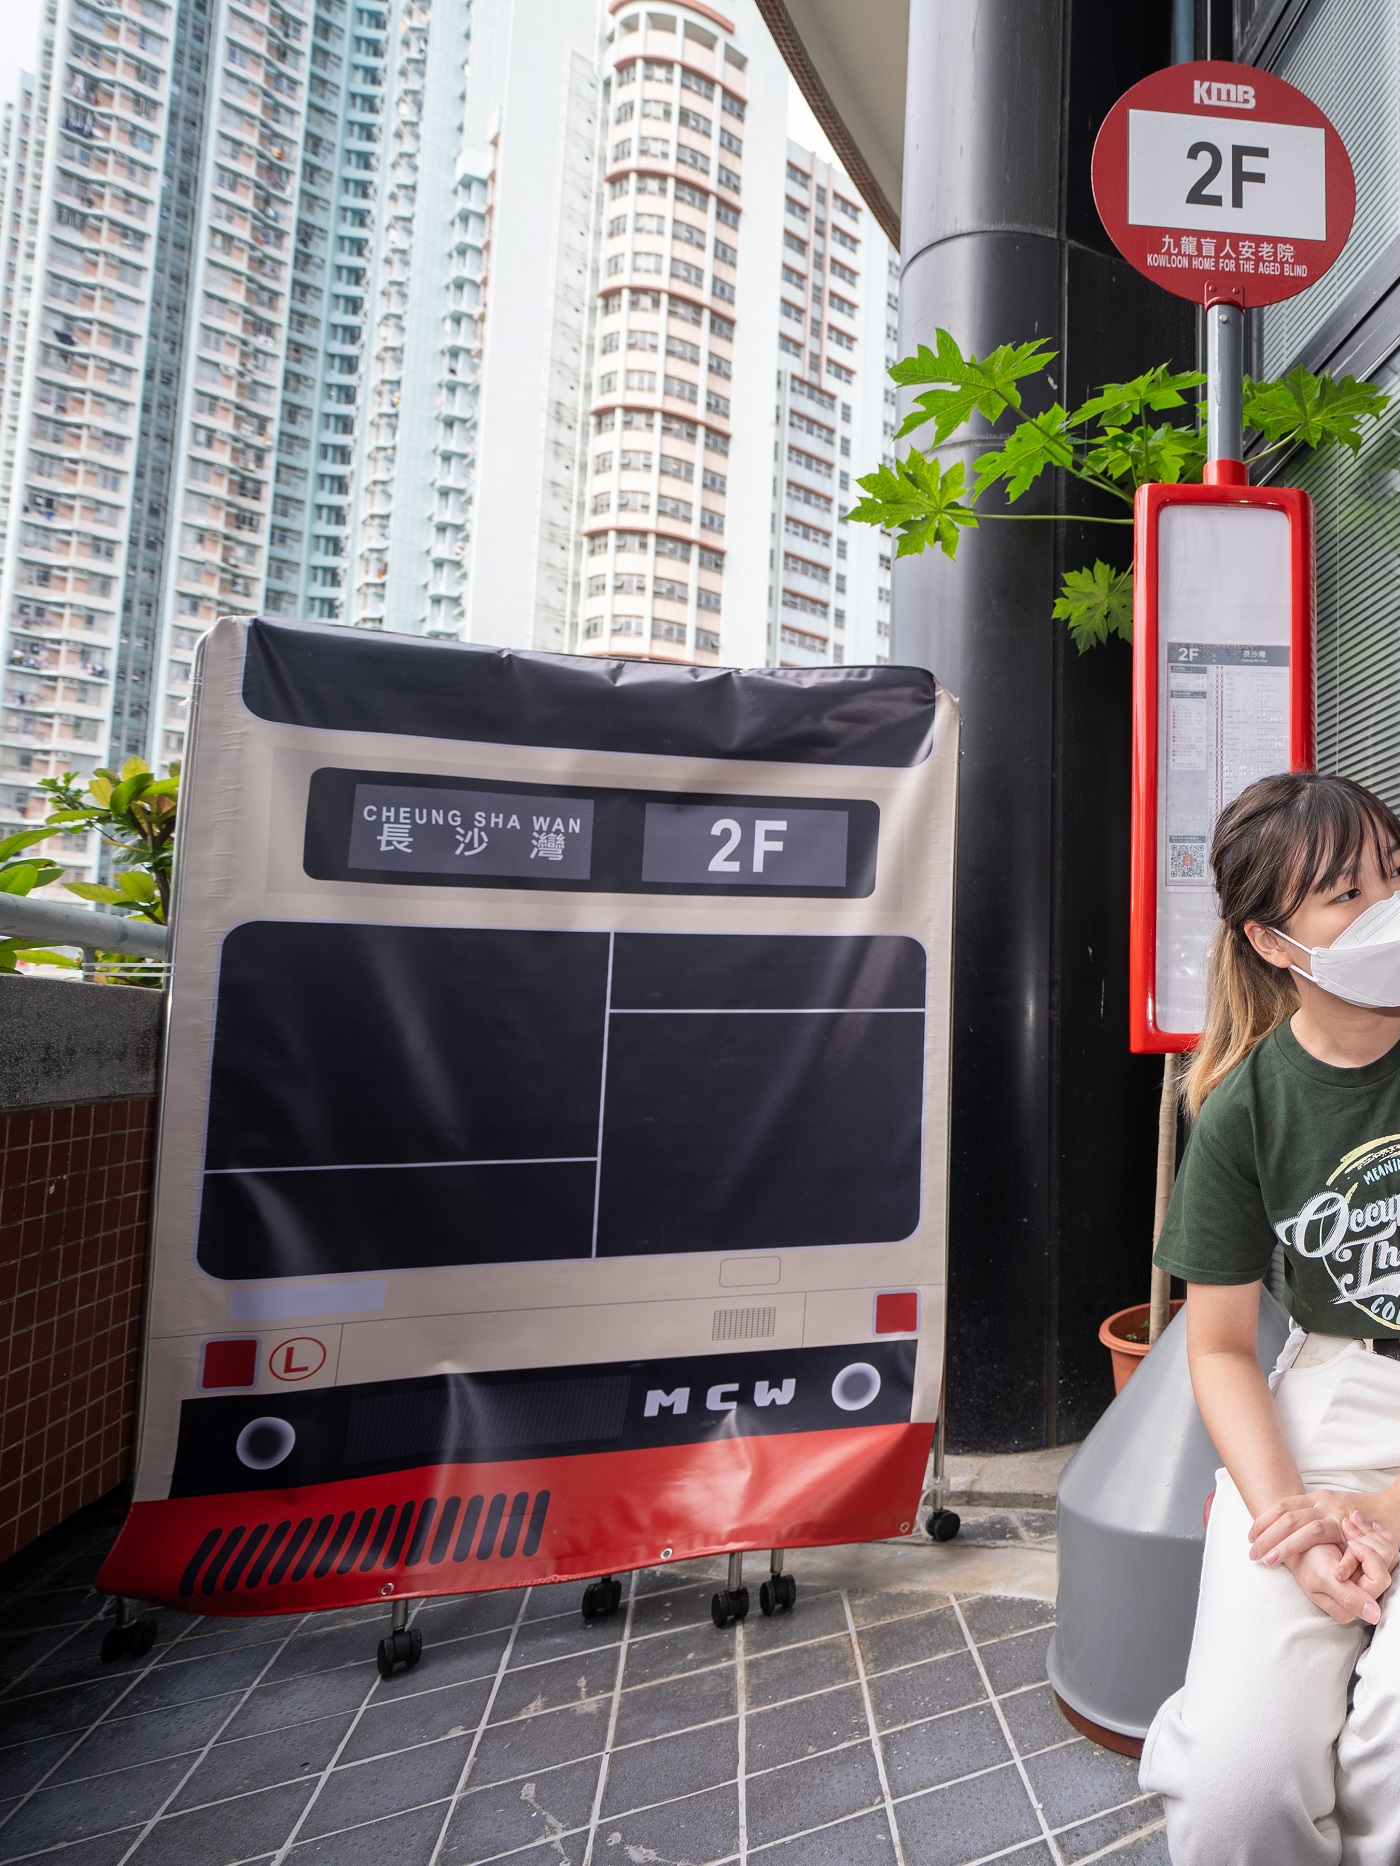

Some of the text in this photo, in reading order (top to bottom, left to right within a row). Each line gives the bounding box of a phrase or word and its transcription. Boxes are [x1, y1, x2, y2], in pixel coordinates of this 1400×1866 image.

[1193, 80, 1256, 109] KMB
[1185, 141, 1269, 209] 2F
[1161, 234, 1295, 263] 九龍盲人安老院
[1147, 253, 1308, 277] KOWLOON HOME FOR THE AGED BLIND
[1178, 647, 1200, 661] 2F
[363, 805, 582, 835] CHEUNG SHA WAN
[376, 823, 566, 862] 長沙灣
[708, 818, 788, 874] 2F
[284, 1344, 310, 1374] L
[643, 1377, 797, 1418] MCW
